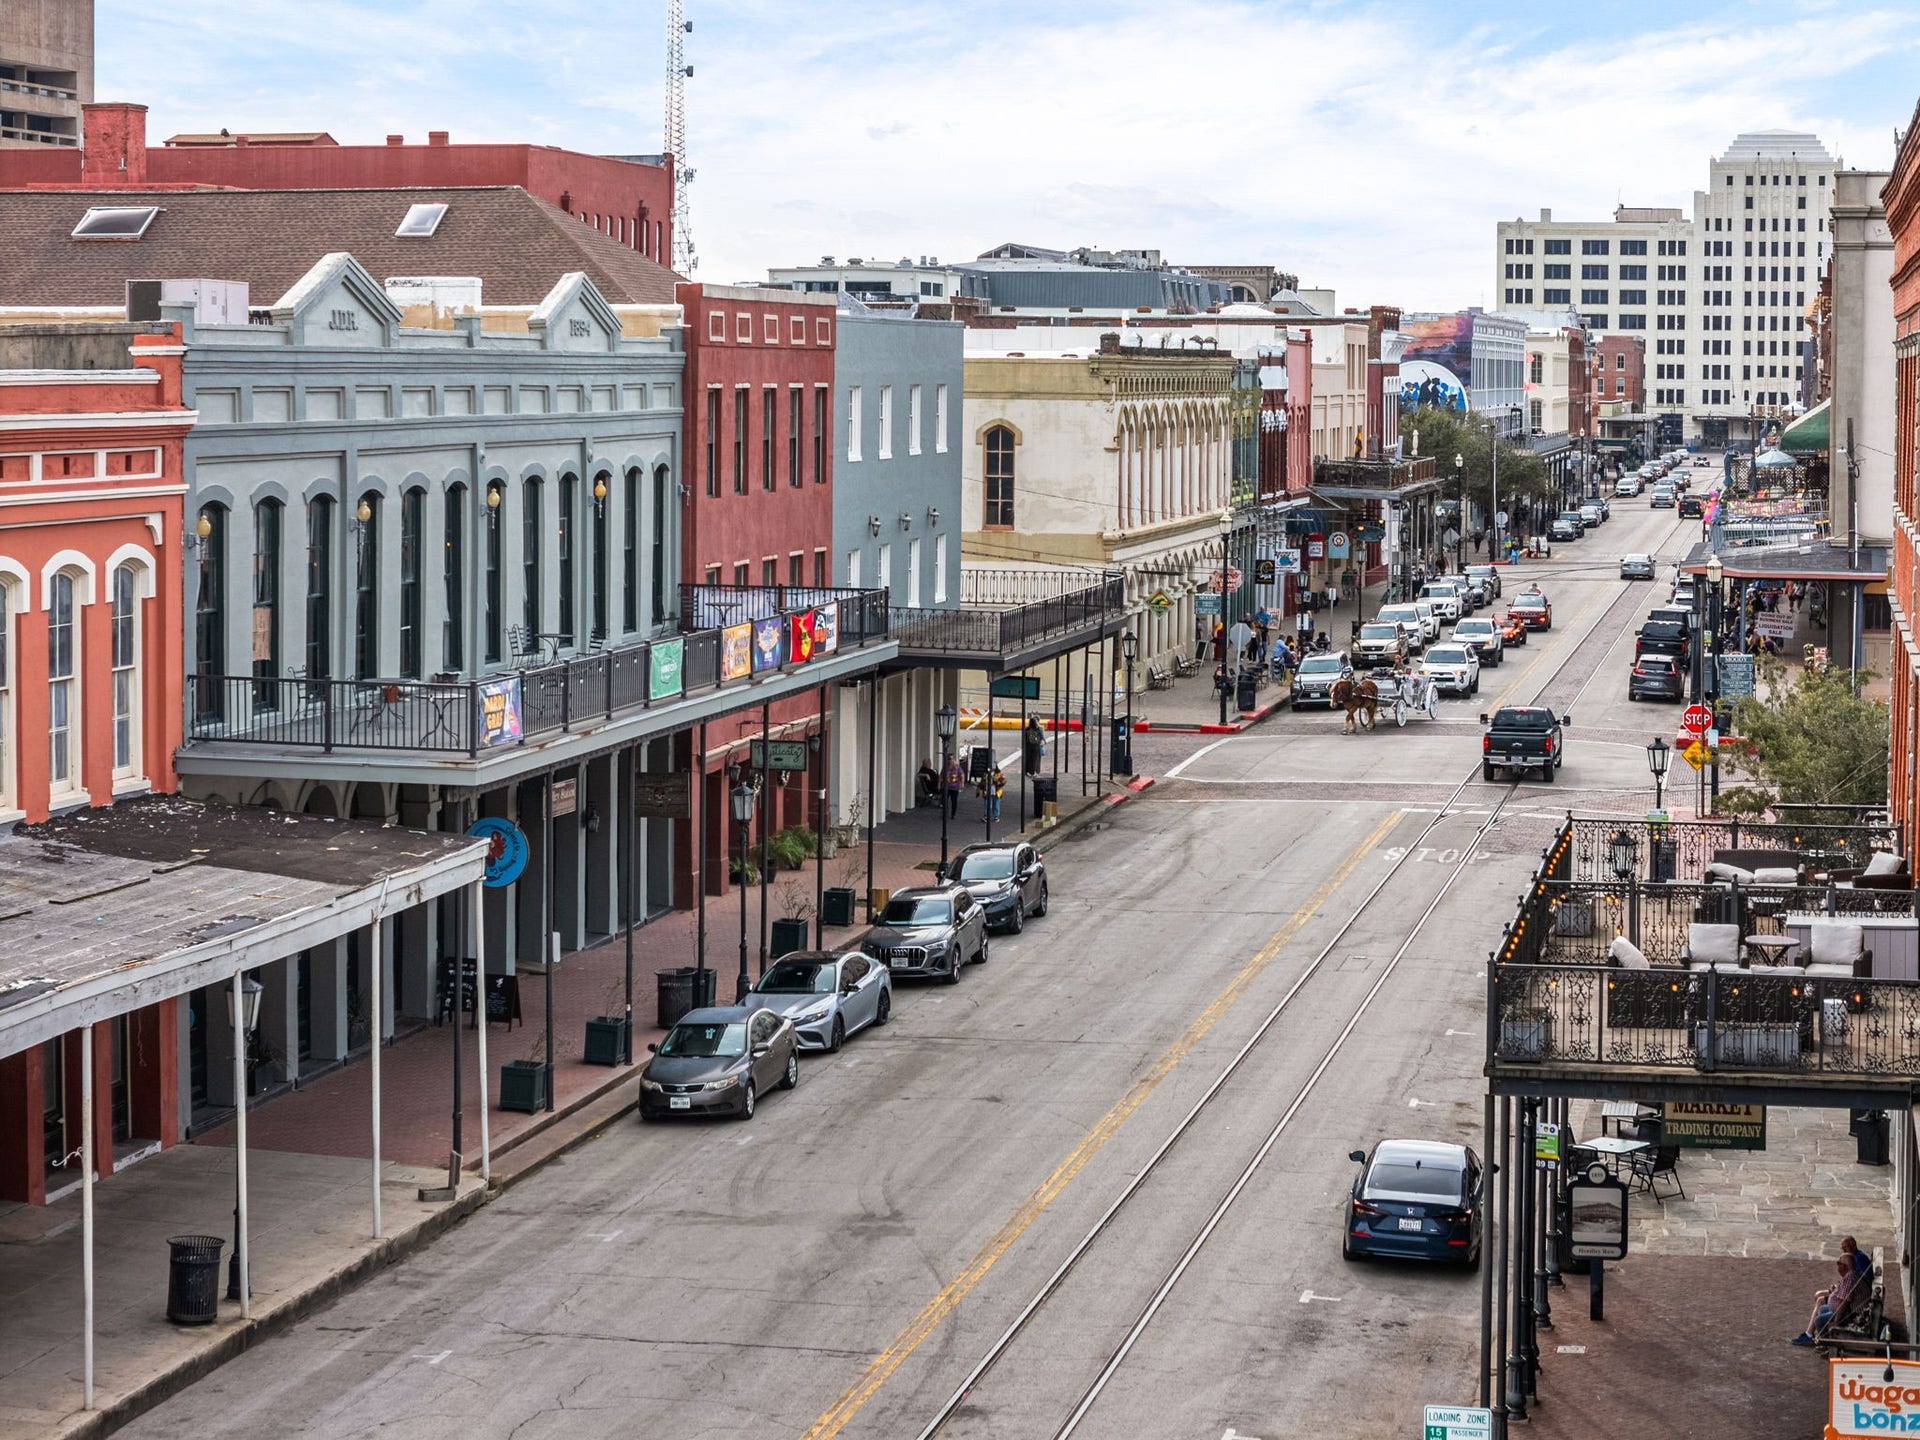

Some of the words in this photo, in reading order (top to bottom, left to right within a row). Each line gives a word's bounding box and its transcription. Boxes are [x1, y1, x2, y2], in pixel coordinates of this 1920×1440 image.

[1685, 713, 1711, 726] STOP
[1383, 846, 1491, 864] STOP
[1665, 1122, 1710, 1136] TRADING
[1712, 1124, 1762, 1138] COMPANY
[1428, 1411, 1461, 1423] LOADING
[1466, 1413, 1487, 1425] ZONE
[1430, 1427, 1442, 1437] 15
[1451, 1429, 1483, 1437] PASSENGER
